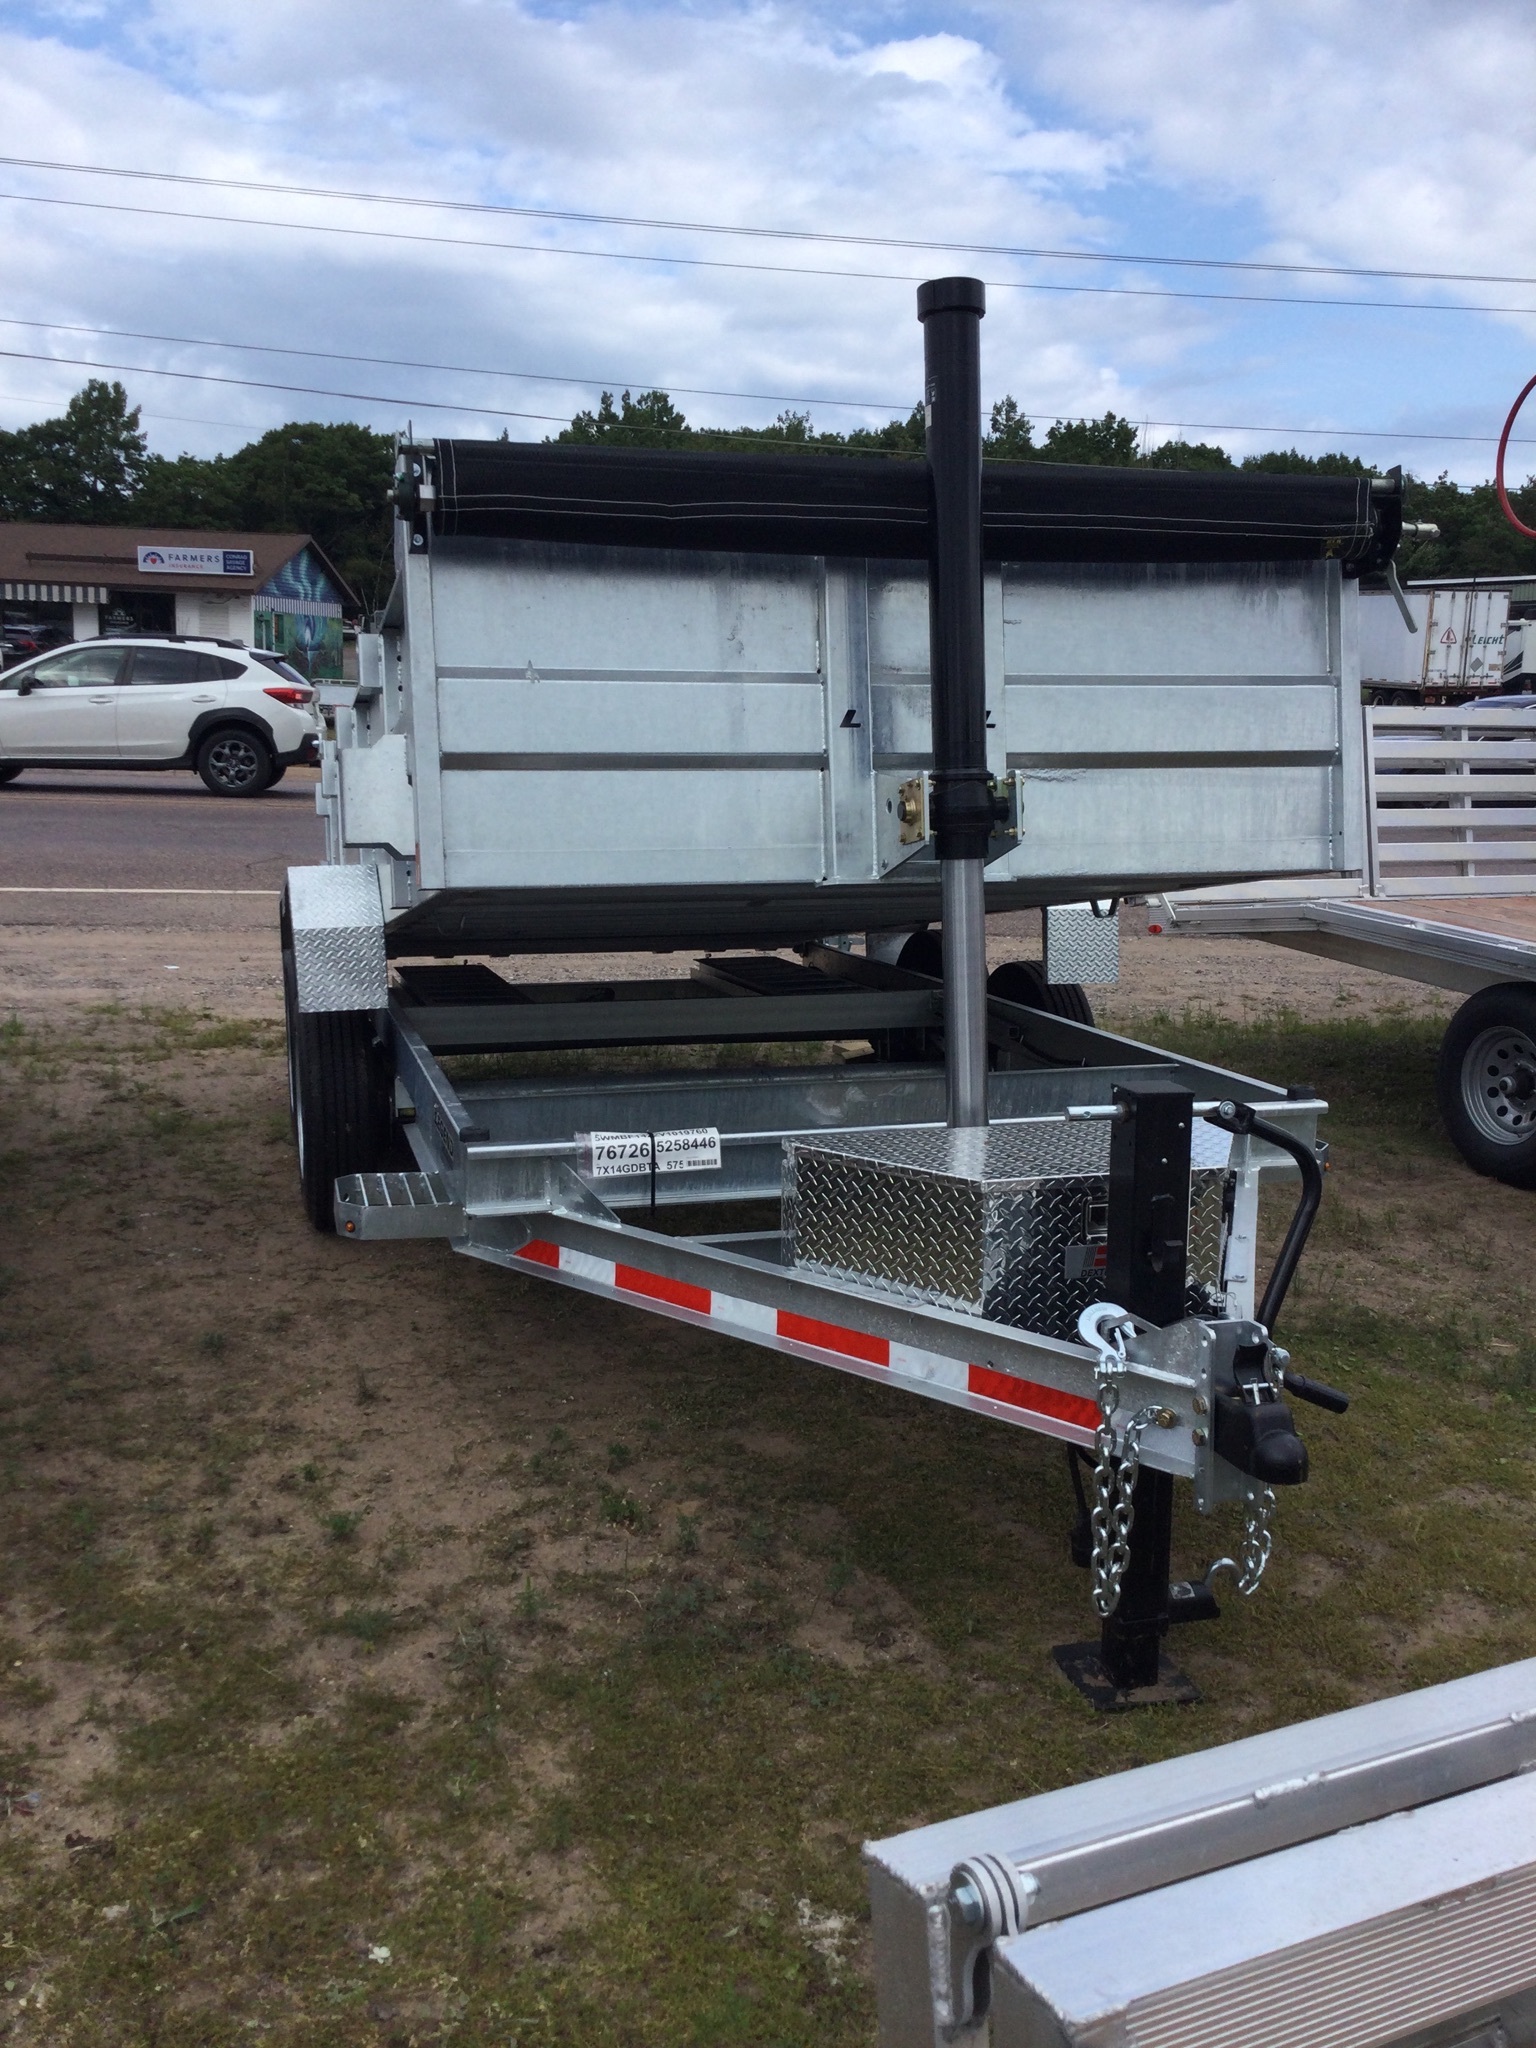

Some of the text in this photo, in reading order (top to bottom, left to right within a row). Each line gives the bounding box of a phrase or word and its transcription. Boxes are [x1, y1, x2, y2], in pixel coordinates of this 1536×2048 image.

[168, 553, 220, 563] FARMERS
[595, 1136, 717, 1160] 76726 5258446
[666, 1159, 684, 1170] 575
[1081, 1268, 1107, 1277] DEXT
